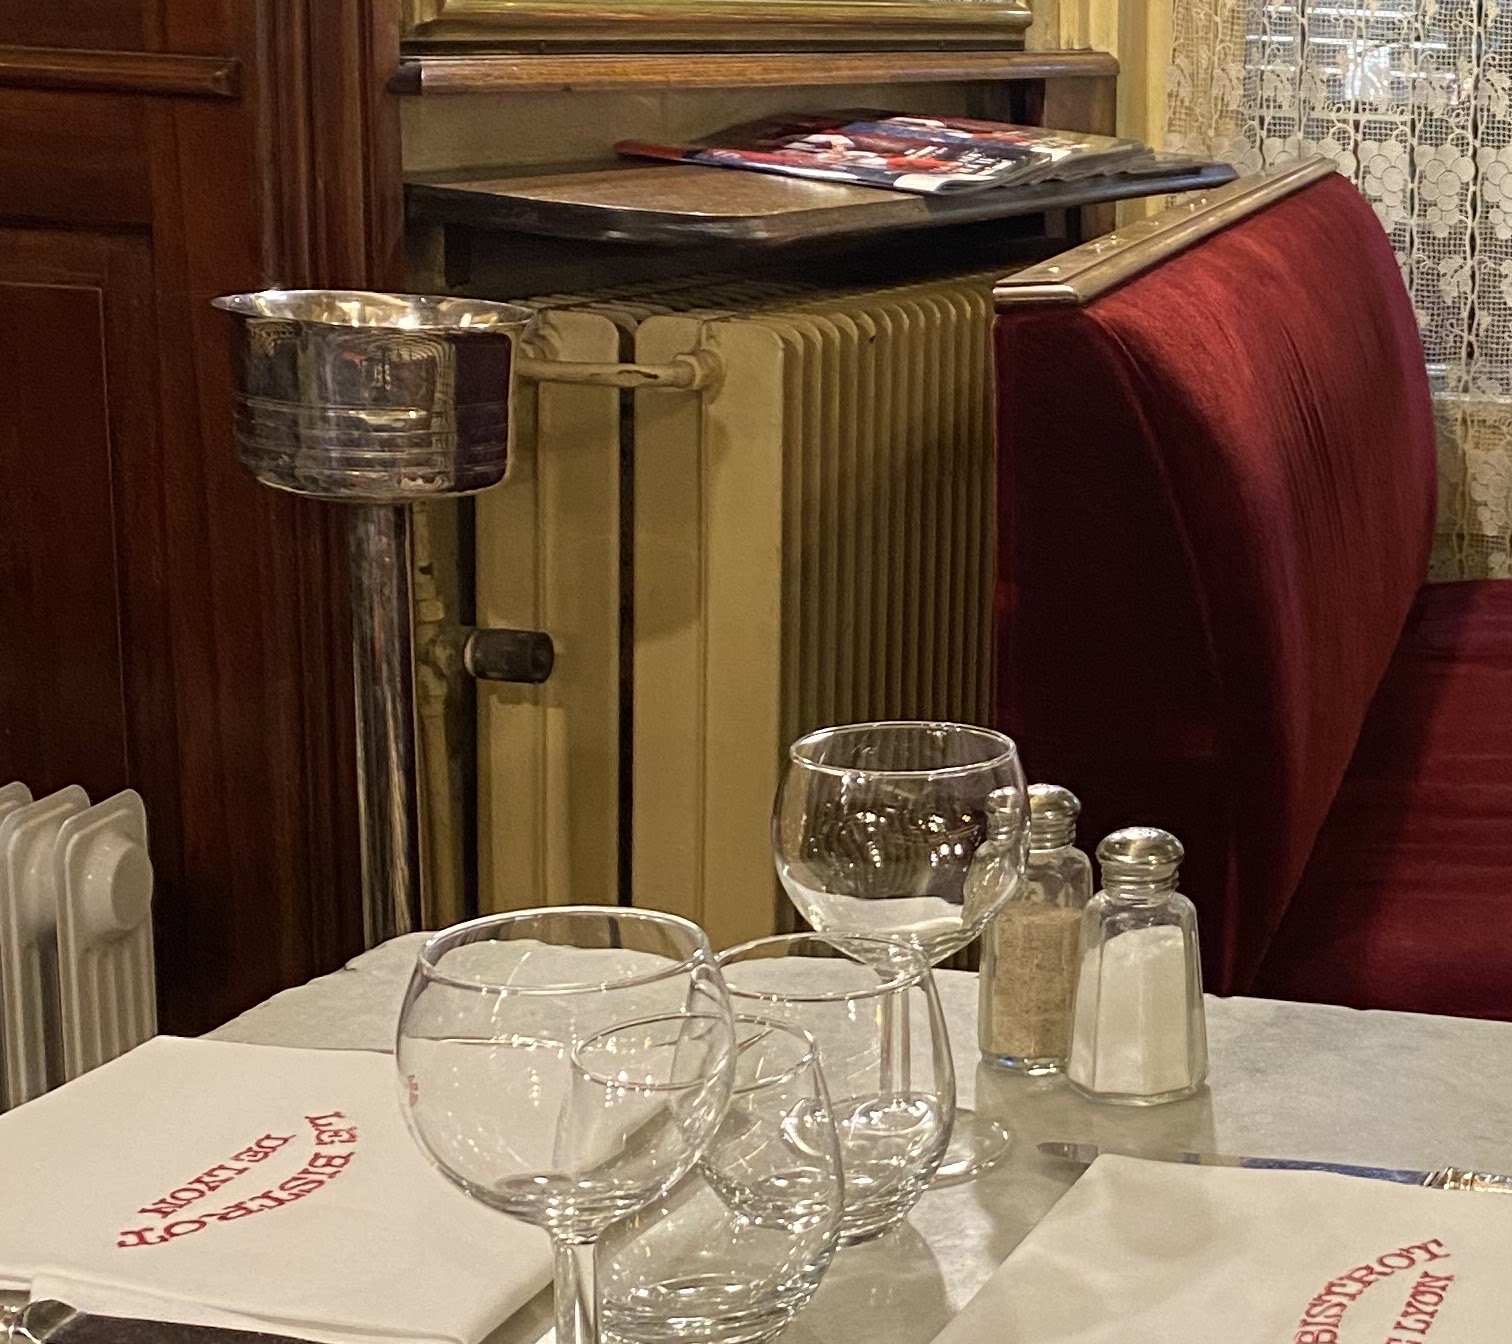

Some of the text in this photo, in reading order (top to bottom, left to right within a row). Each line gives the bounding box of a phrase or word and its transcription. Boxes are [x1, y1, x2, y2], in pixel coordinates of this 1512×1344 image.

[117, 1111, 358, 1248] LE BISTROT
[137, 1133, 297, 1219] DE LYON
[1392, 1271, 1455, 1336] LYON
